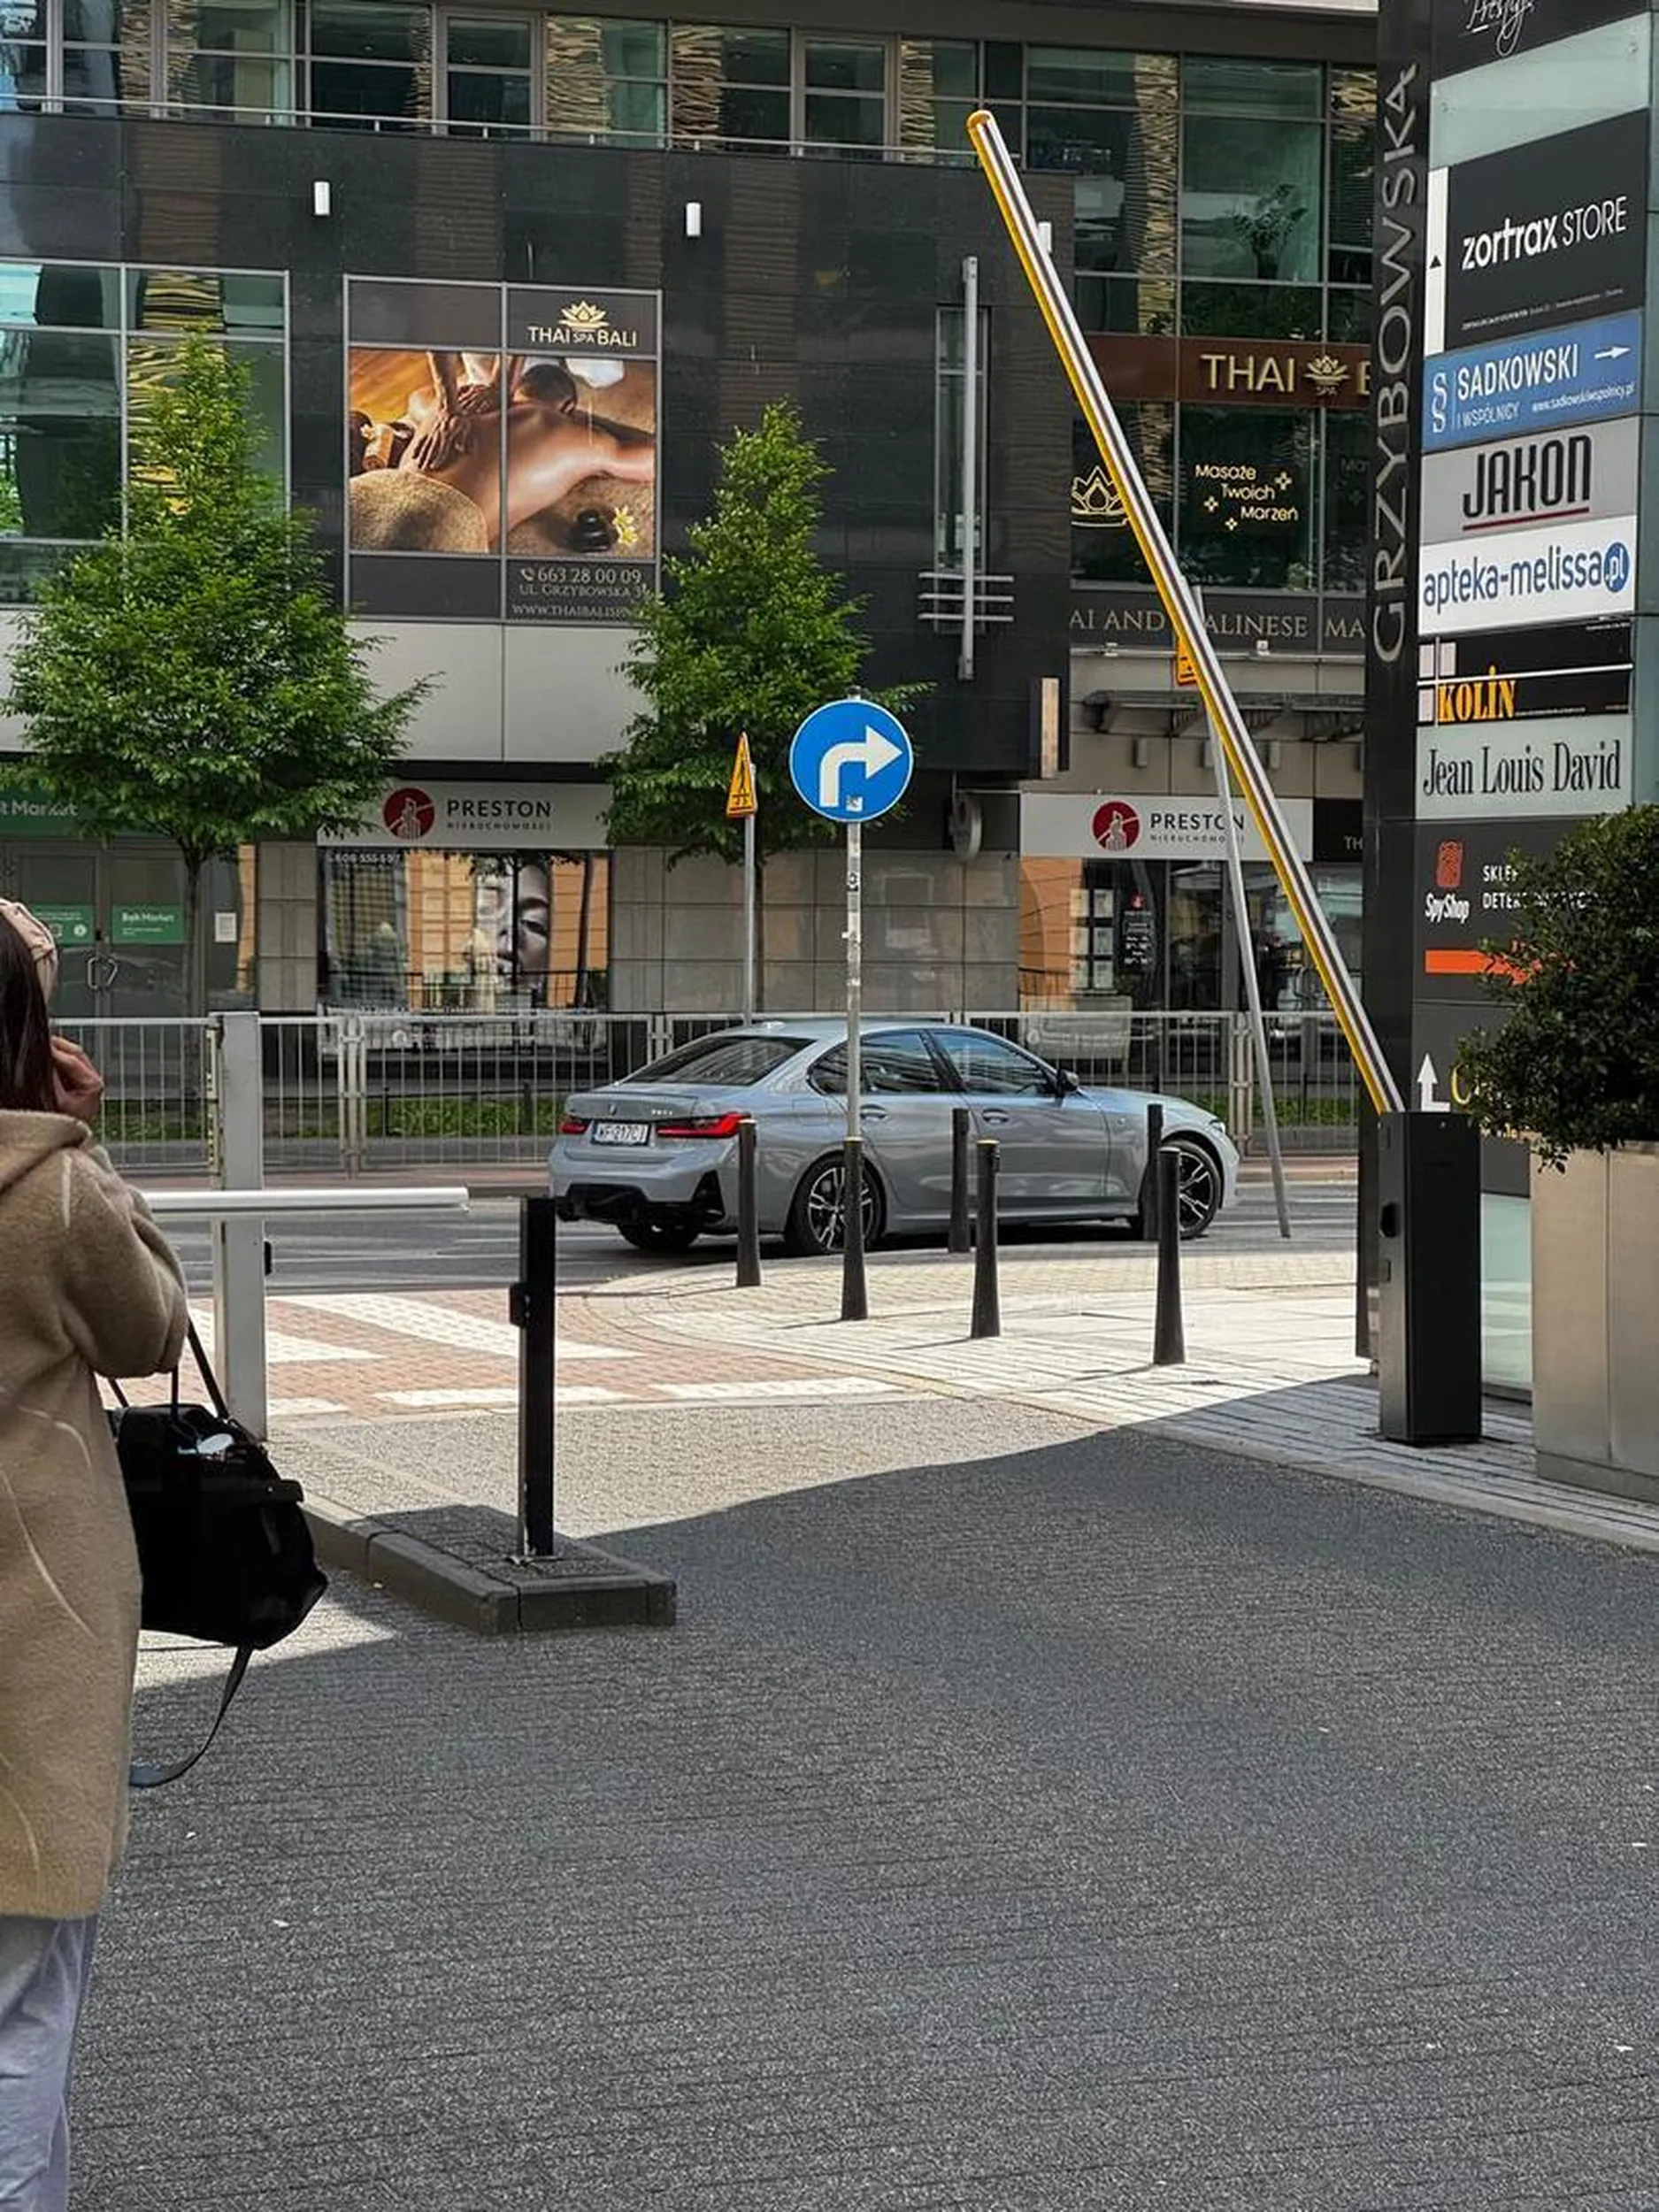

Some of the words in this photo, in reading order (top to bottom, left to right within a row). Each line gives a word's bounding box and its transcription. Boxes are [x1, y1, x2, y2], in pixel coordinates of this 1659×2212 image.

[1461, 211, 1558, 272] zortrax
[1562, 196, 1627, 248] STORE
[527, 326, 571, 344] THAI
[596, 329, 637, 348] BALI
[1200, 354, 1296, 393] THAI
[1372, 63, 1417, 664] GRZYBOWSKA
[1457, 342, 1578, 402] SADKOWSKI
[1220, 482, 1276, 501] Twoich
[1462, 434, 1594, 519] JAKON
[538, 566, 566, 584] 663
[570, 567, 591, 584] 28
[595, 568, 617, 585] 00
[620, 568, 641, 585] 09
[541, 583, 632, 598] GRZYBOWSKA
[1104, 609, 1166, 633] AND
[1205, 613, 1309, 639] ALINESE
[1422, 747, 1474, 796] Jean
[1480, 743, 1544, 795] Louis
[1552, 739, 1622, 794] David
[446, 799, 553, 818] PRESTON
